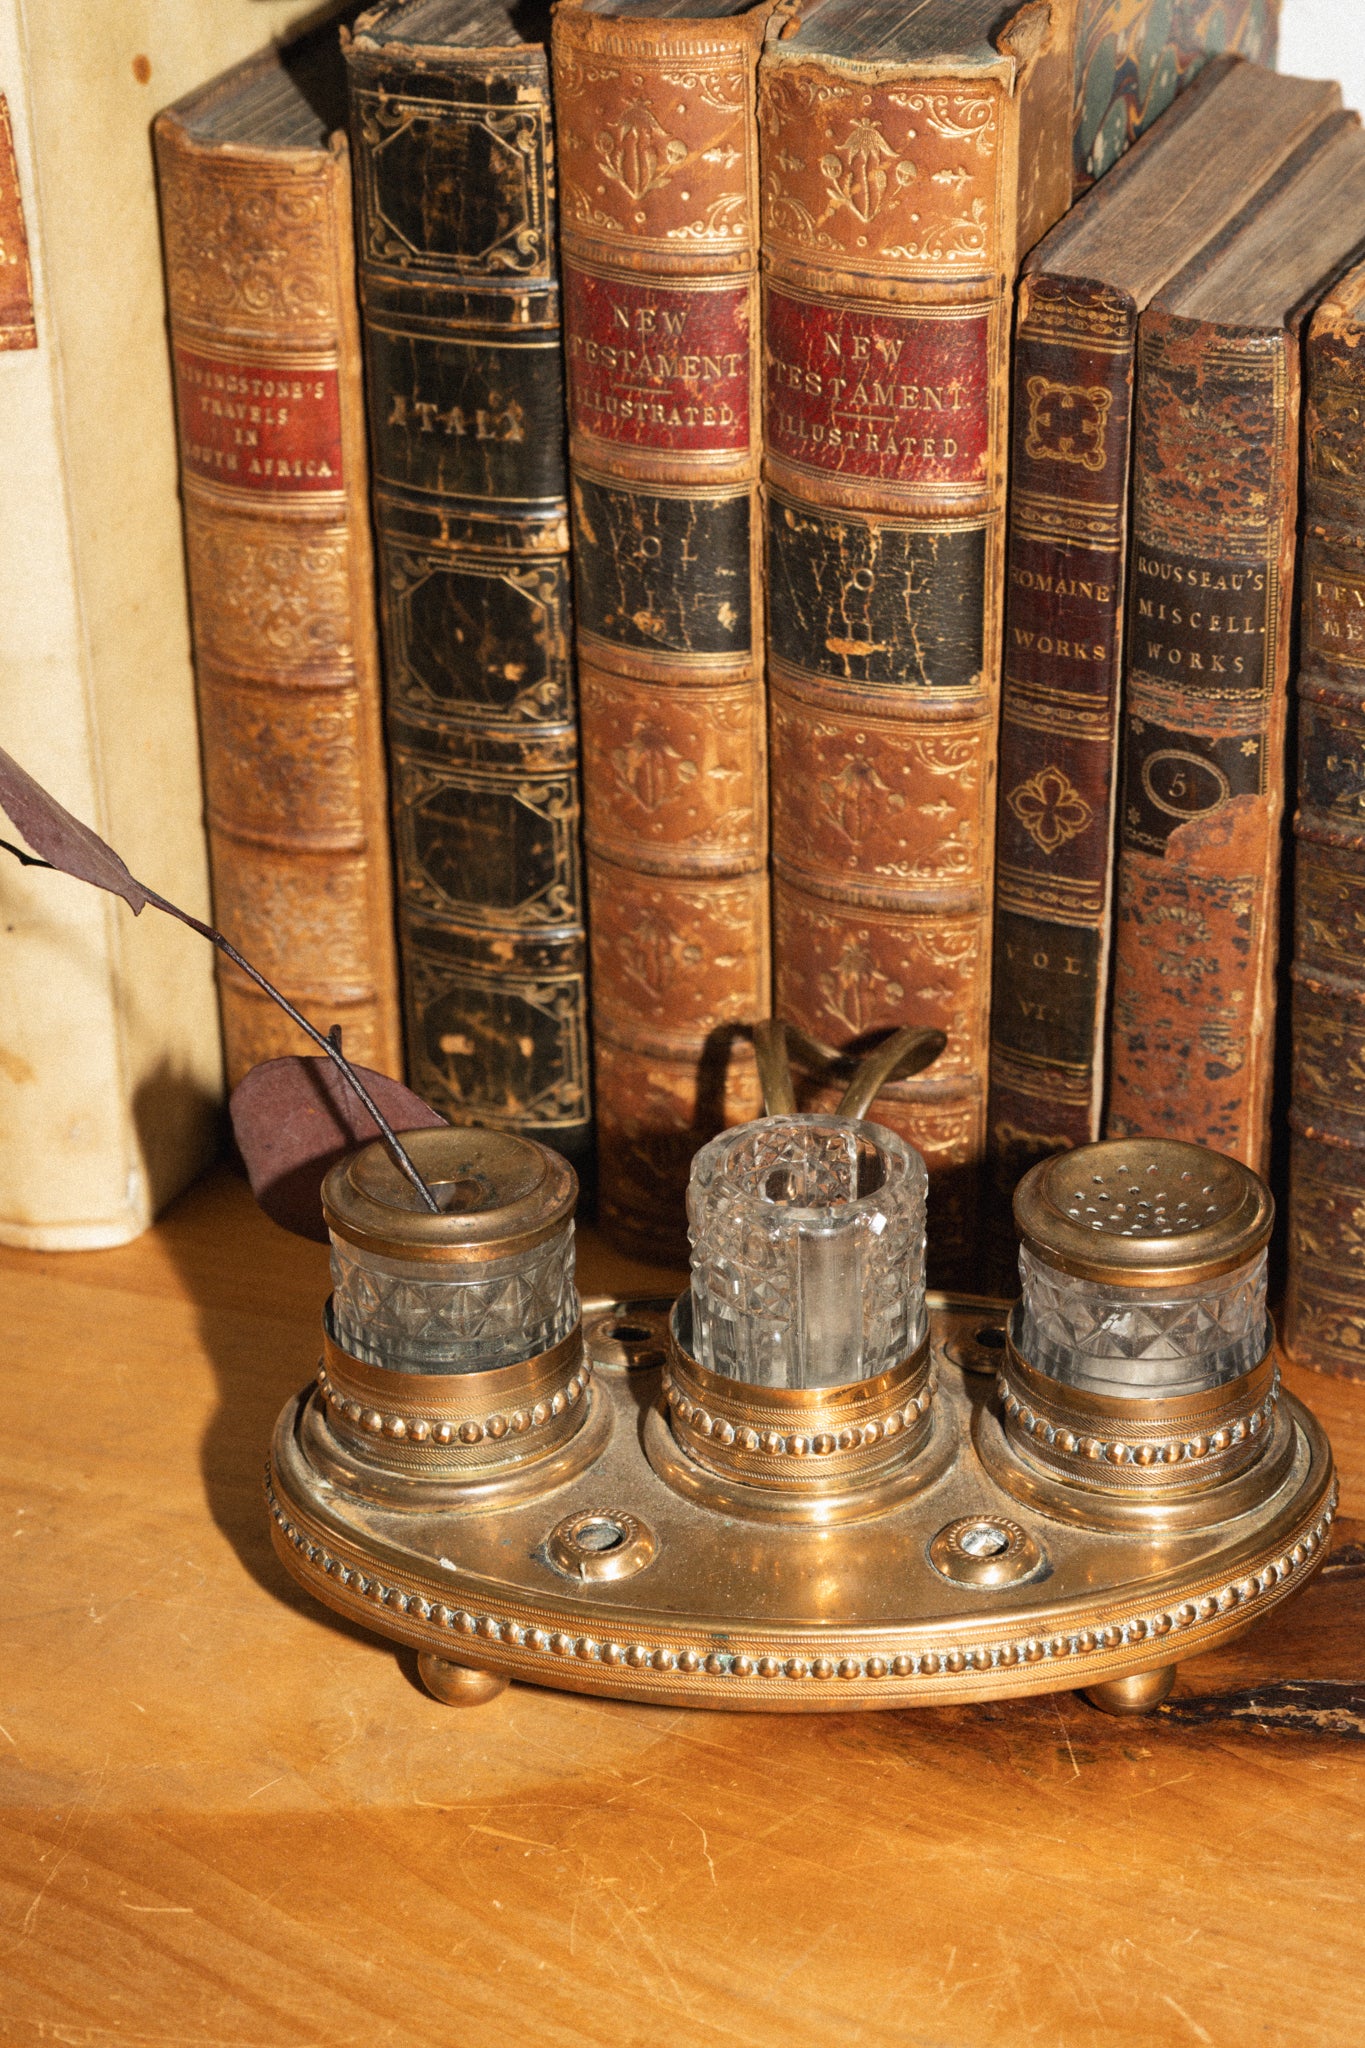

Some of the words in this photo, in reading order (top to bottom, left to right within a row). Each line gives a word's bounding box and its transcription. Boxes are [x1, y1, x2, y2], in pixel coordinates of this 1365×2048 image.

[614, 304, 688, 335] NEW
[824, 331, 906, 364] NEW
[201, 396, 289, 426] TRAVELS
[234, 427, 259, 447] IN
[1138, 555, 1265, 592] ROUSSEAU'S
[1139, 598, 1267, 634] MISCELL.
[1014, 627, 1107, 662] WORKS
[1147, 641, 1245, 674] WORKS
[1168, 773, 1186, 798] 5
